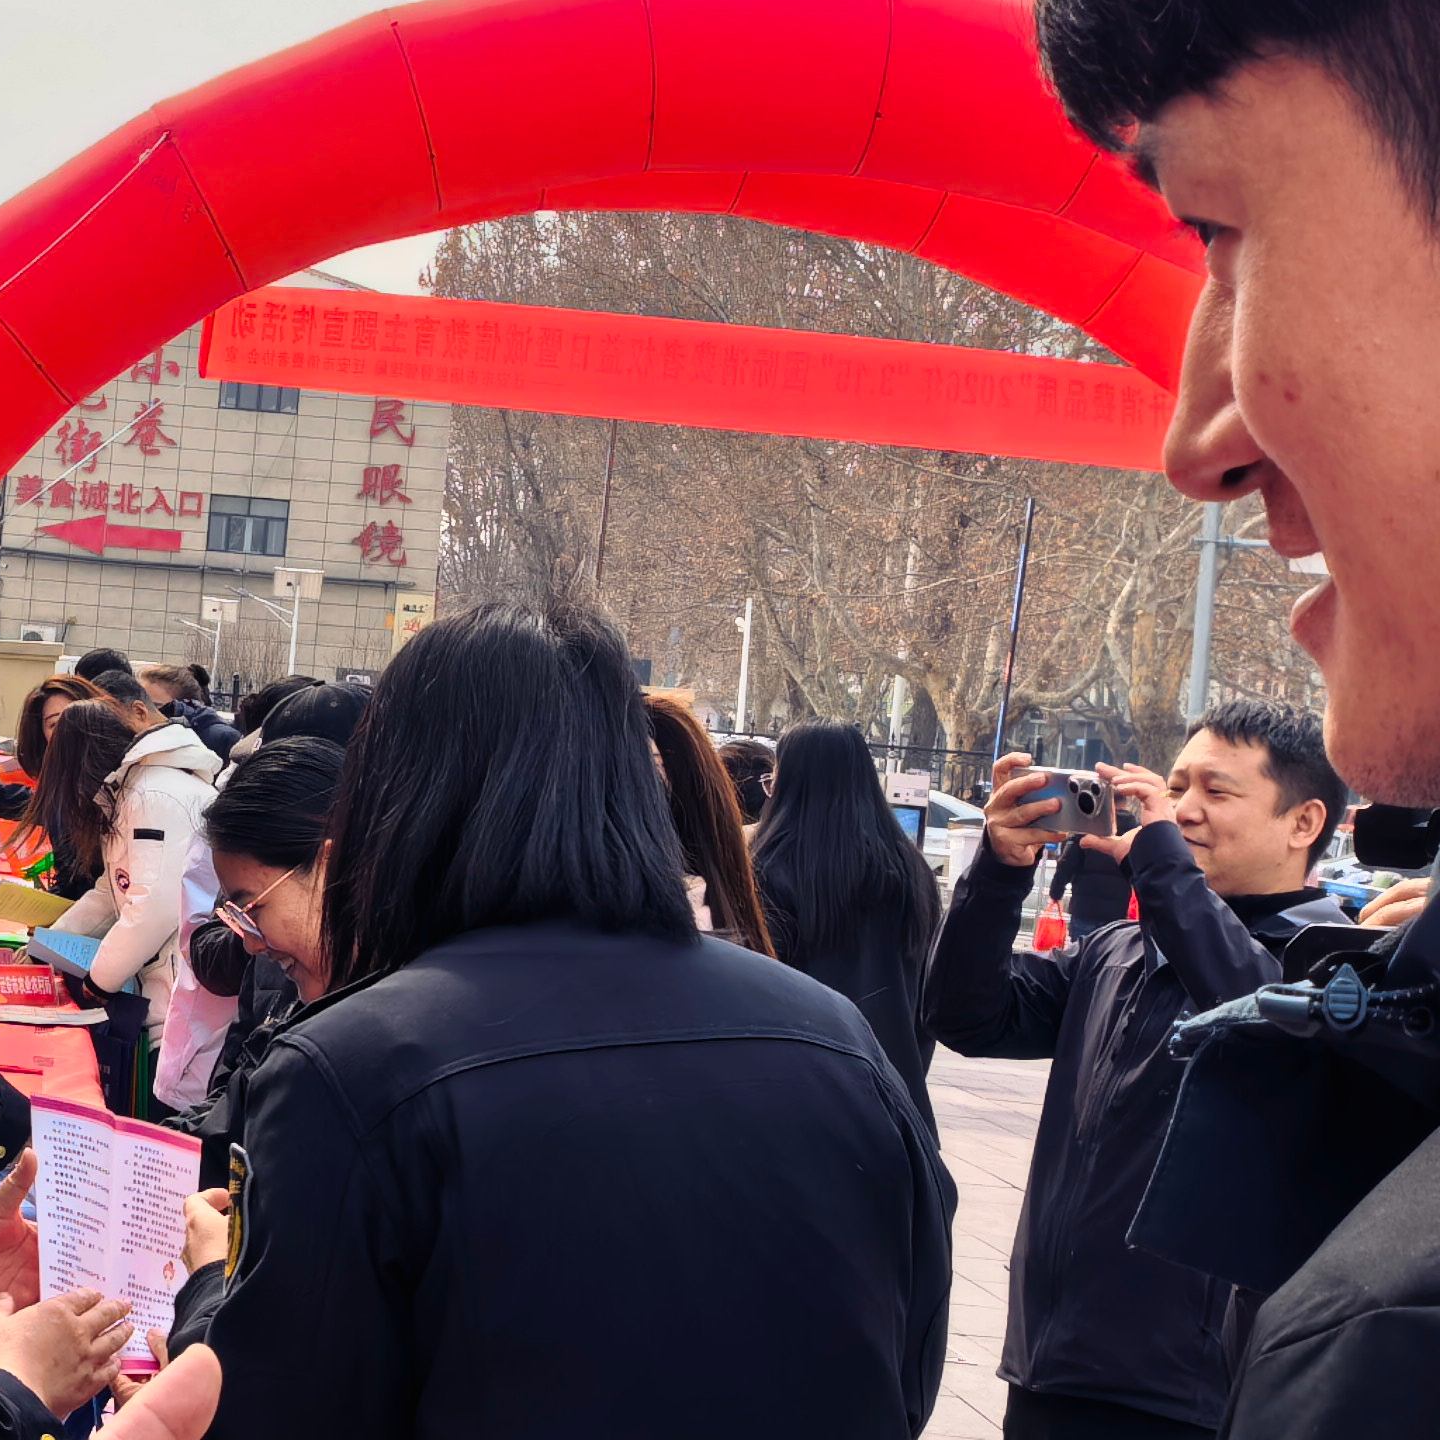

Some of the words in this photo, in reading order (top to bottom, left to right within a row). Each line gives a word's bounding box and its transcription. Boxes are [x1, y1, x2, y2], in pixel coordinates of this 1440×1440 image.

[15, 474, 204, 517] 美食城北入口
